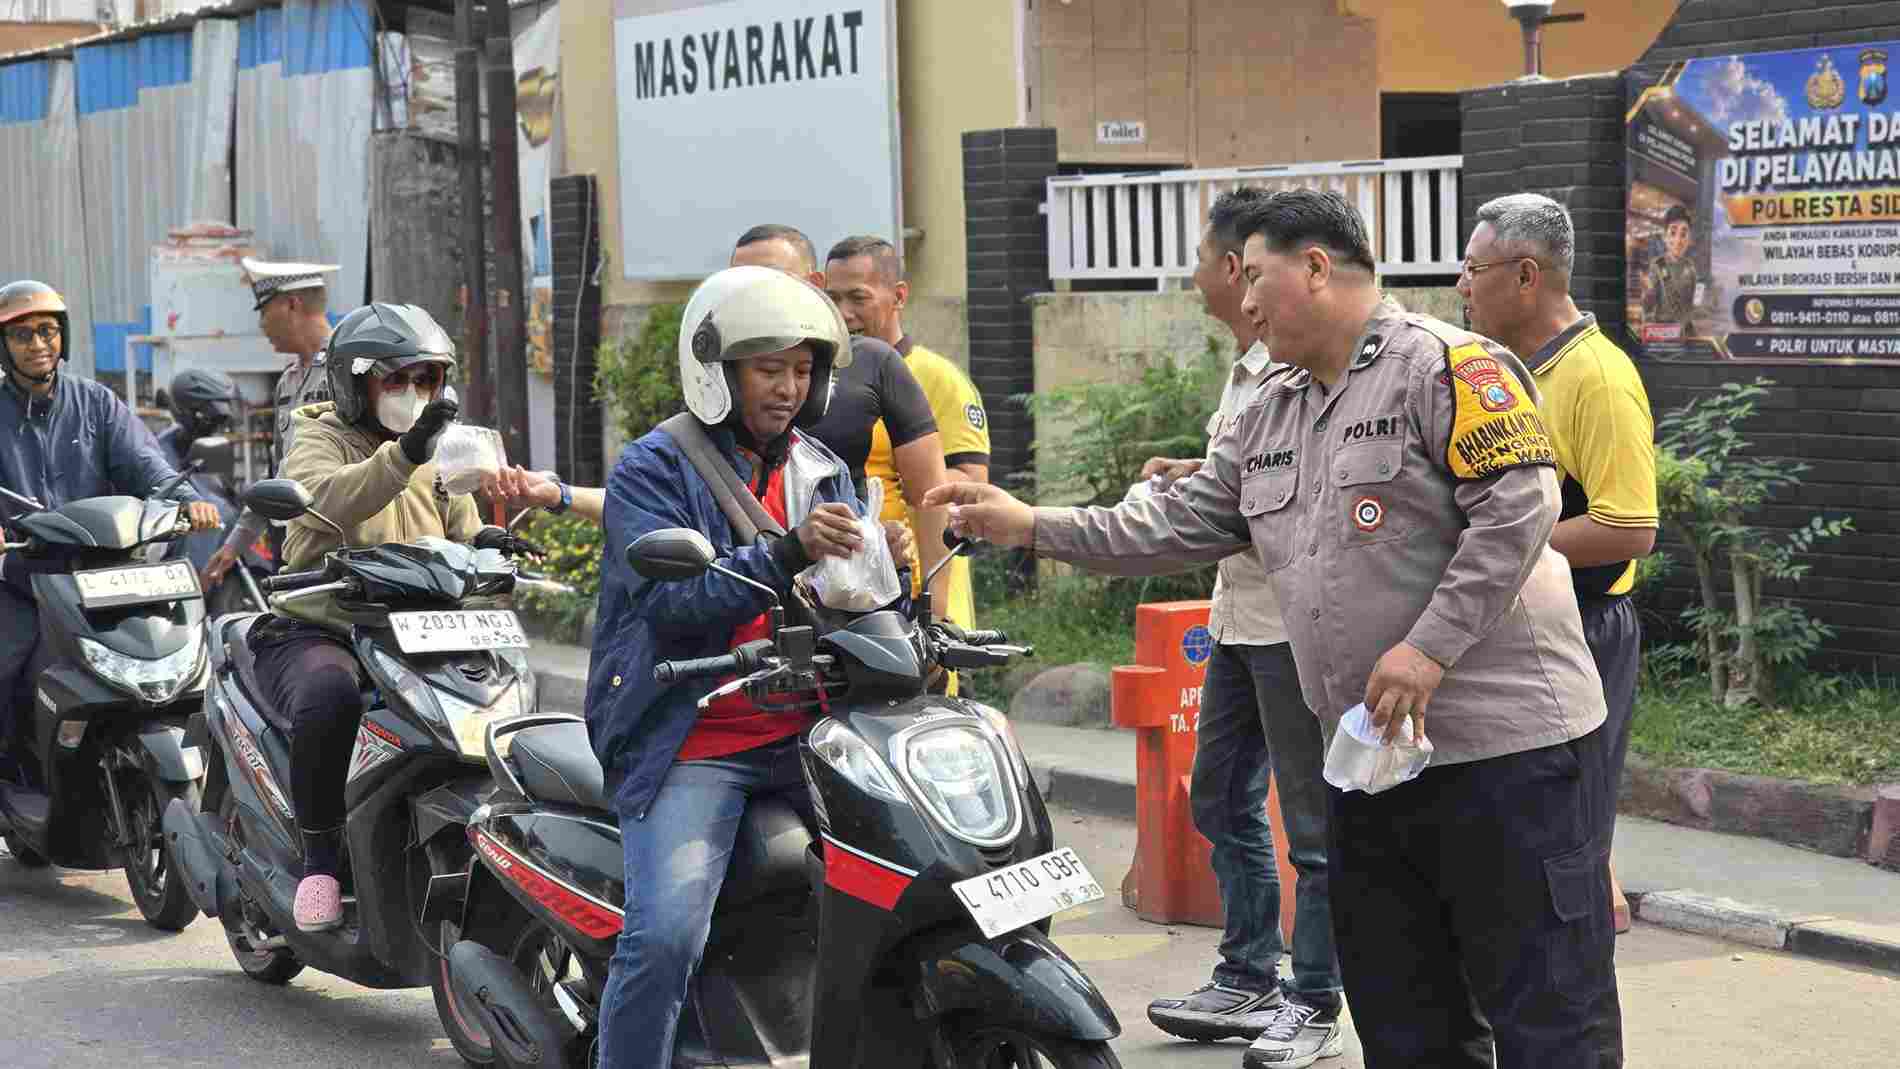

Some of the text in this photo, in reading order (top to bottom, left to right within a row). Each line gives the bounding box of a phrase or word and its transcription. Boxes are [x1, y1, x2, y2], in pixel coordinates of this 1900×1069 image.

[634, 10, 863, 100] MASYARAKAT
[1102, 123, 1141, 139] Toilet
[1728, 114, 1859, 151] SELAMAT
[1722, 148, 1900, 187] DI PELAYANA
[1752, 196, 1862, 220] POLRESTA
[1763, 245, 1814, 260] WILAYAH
[1817, 244, 1855, 259] BEBAS
[1738, 273, 1779, 287] WILAYAH
[1782, 272, 1833, 285] BIROKRASI
[1834, 271, 1868, 285] BERSIH
[1871, 270, 1891, 284] DAN
[1770, 339, 1807, 353] POLRI
[1810, 339, 1855, 353] UNTUK
[1343, 416, 1397, 443] POLRI
[1246, 450, 1294, 473] CHARIS
[395, 612, 513, 631] W 2037 NGJ
[958, 851, 1081, 909] L 4710 CBF
